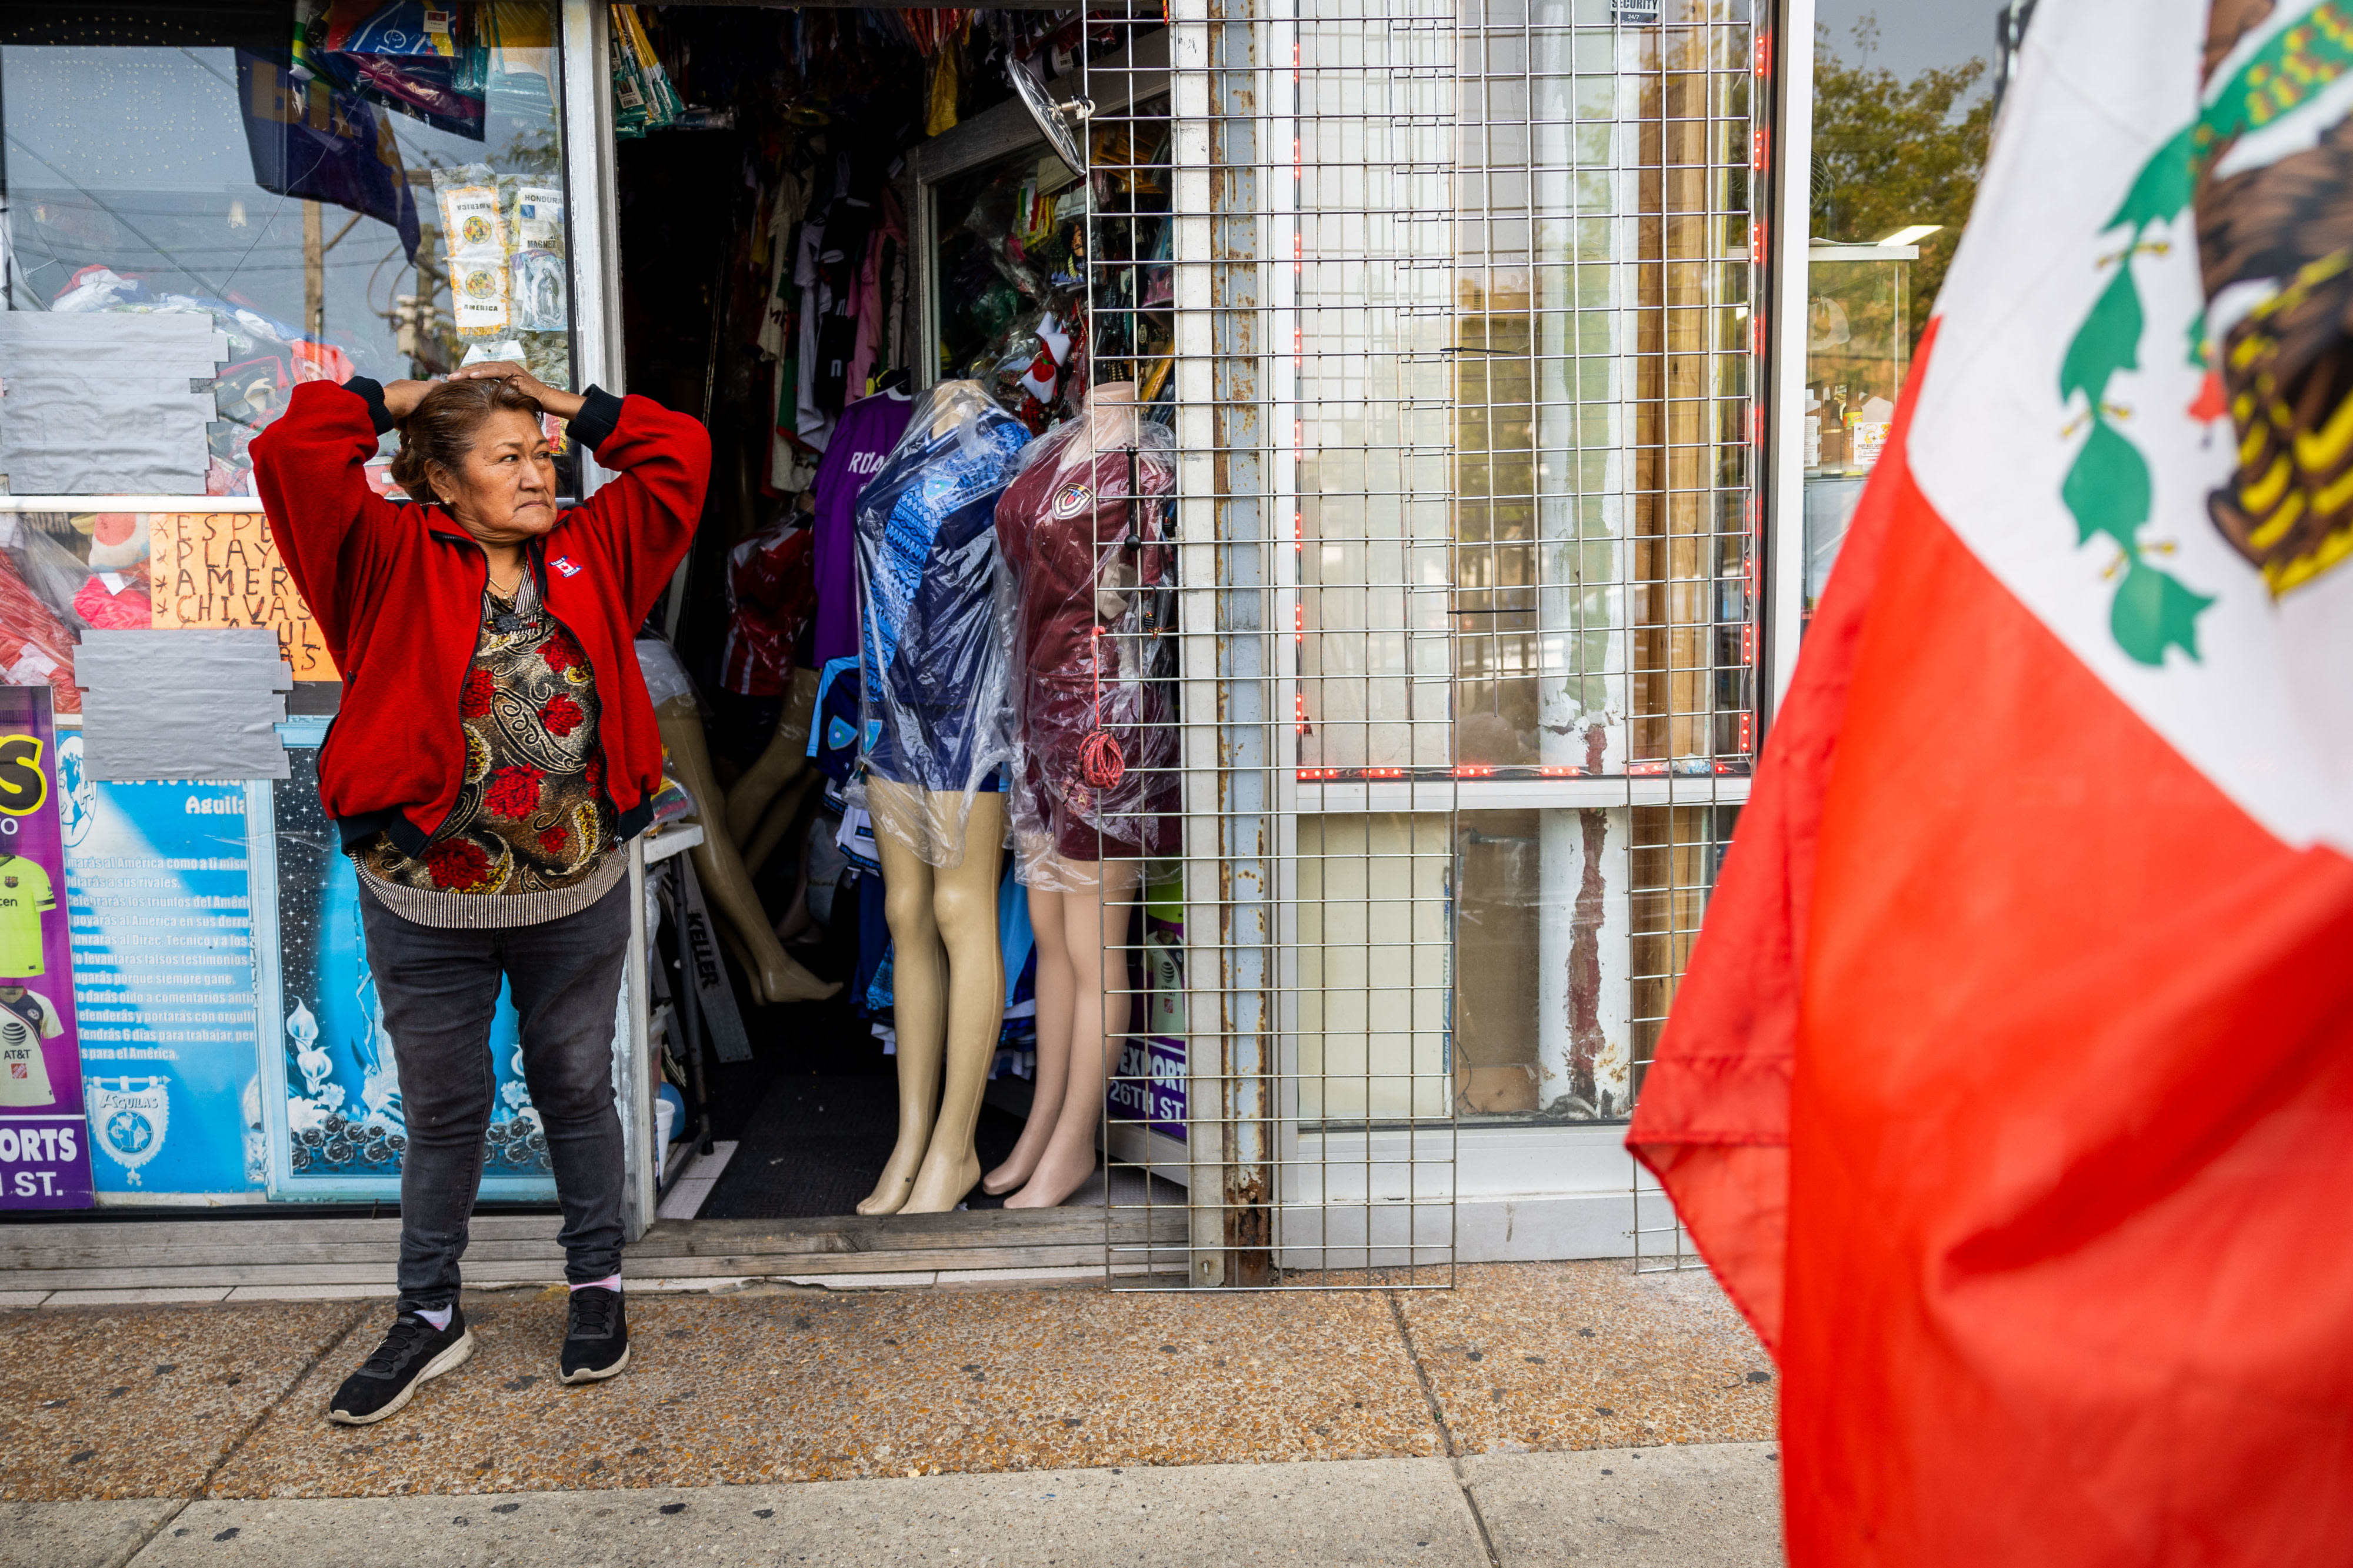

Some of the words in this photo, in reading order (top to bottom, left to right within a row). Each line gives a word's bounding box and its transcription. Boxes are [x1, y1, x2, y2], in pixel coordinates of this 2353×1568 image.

[456, 203, 491, 211] AMERICA
[527, 240, 556, 248] MAGNET
[177, 539, 285, 569] PLAY
[175, 567, 301, 596] AMER
[176, 594, 313, 624] CHIVAS
[65, 856, 102, 869] marás
[104, 857, 115, 869] al
[118, 857, 164, 869] América
[166, 858, 198, 869] como
[199, 859, 206, 869] a
[208, 858, 217, 869] ti
[108, 879, 115, 888] a
[117, 878, 136, 888] sus
[139, 877, 181, 889] rivales.
[128, 896, 145, 907] los
[148, 897, 191, 908] triunfos
[193, 896, 211, 908] del
[71, 914, 117, 928] poyarás
[119, 916, 129, 926] al
[131, 915, 176, 927] América
[179, 918, 194, 927] en
[196, 918, 216, 928] sus
[71, 933, 117, 945] onrarás
[119, 935, 129, 945] al
[132, 935, 164, 946] Direc.
[213, 936, 219, 947] y
[221, 936, 228, 946] a
[230, 935, 247, 946] los
[688, 912, 721, 990] KELLER
[84, 952, 142, 964] levantarás
[145, 954, 179, 965] falsos
[181, 955, 248, 966] testimonios
[114, 973, 153, 985] porque
[155, 973, 202, 985] siempre
[204, 975, 235, 986] gane.
[85, 990, 118, 1003] darás
[146, 993, 152, 1003] a
[155, 992, 225, 1003] comentarios
[135, 1011, 142, 1023] y
[144, 1009, 192, 1023] portarás
[195, 1012, 215, 1022] con
[123, 1029, 131, 1041] 6
[158, 1030, 184, 1042] para
[4, 1049, 32, 1059] AT&T
[89, 1049, 115, 1060] para
[116, 1047, 128, 1060] el
[1109, 1079, 1154, 1115] 26TH
[14, 1172, 64, 1197] ST.
